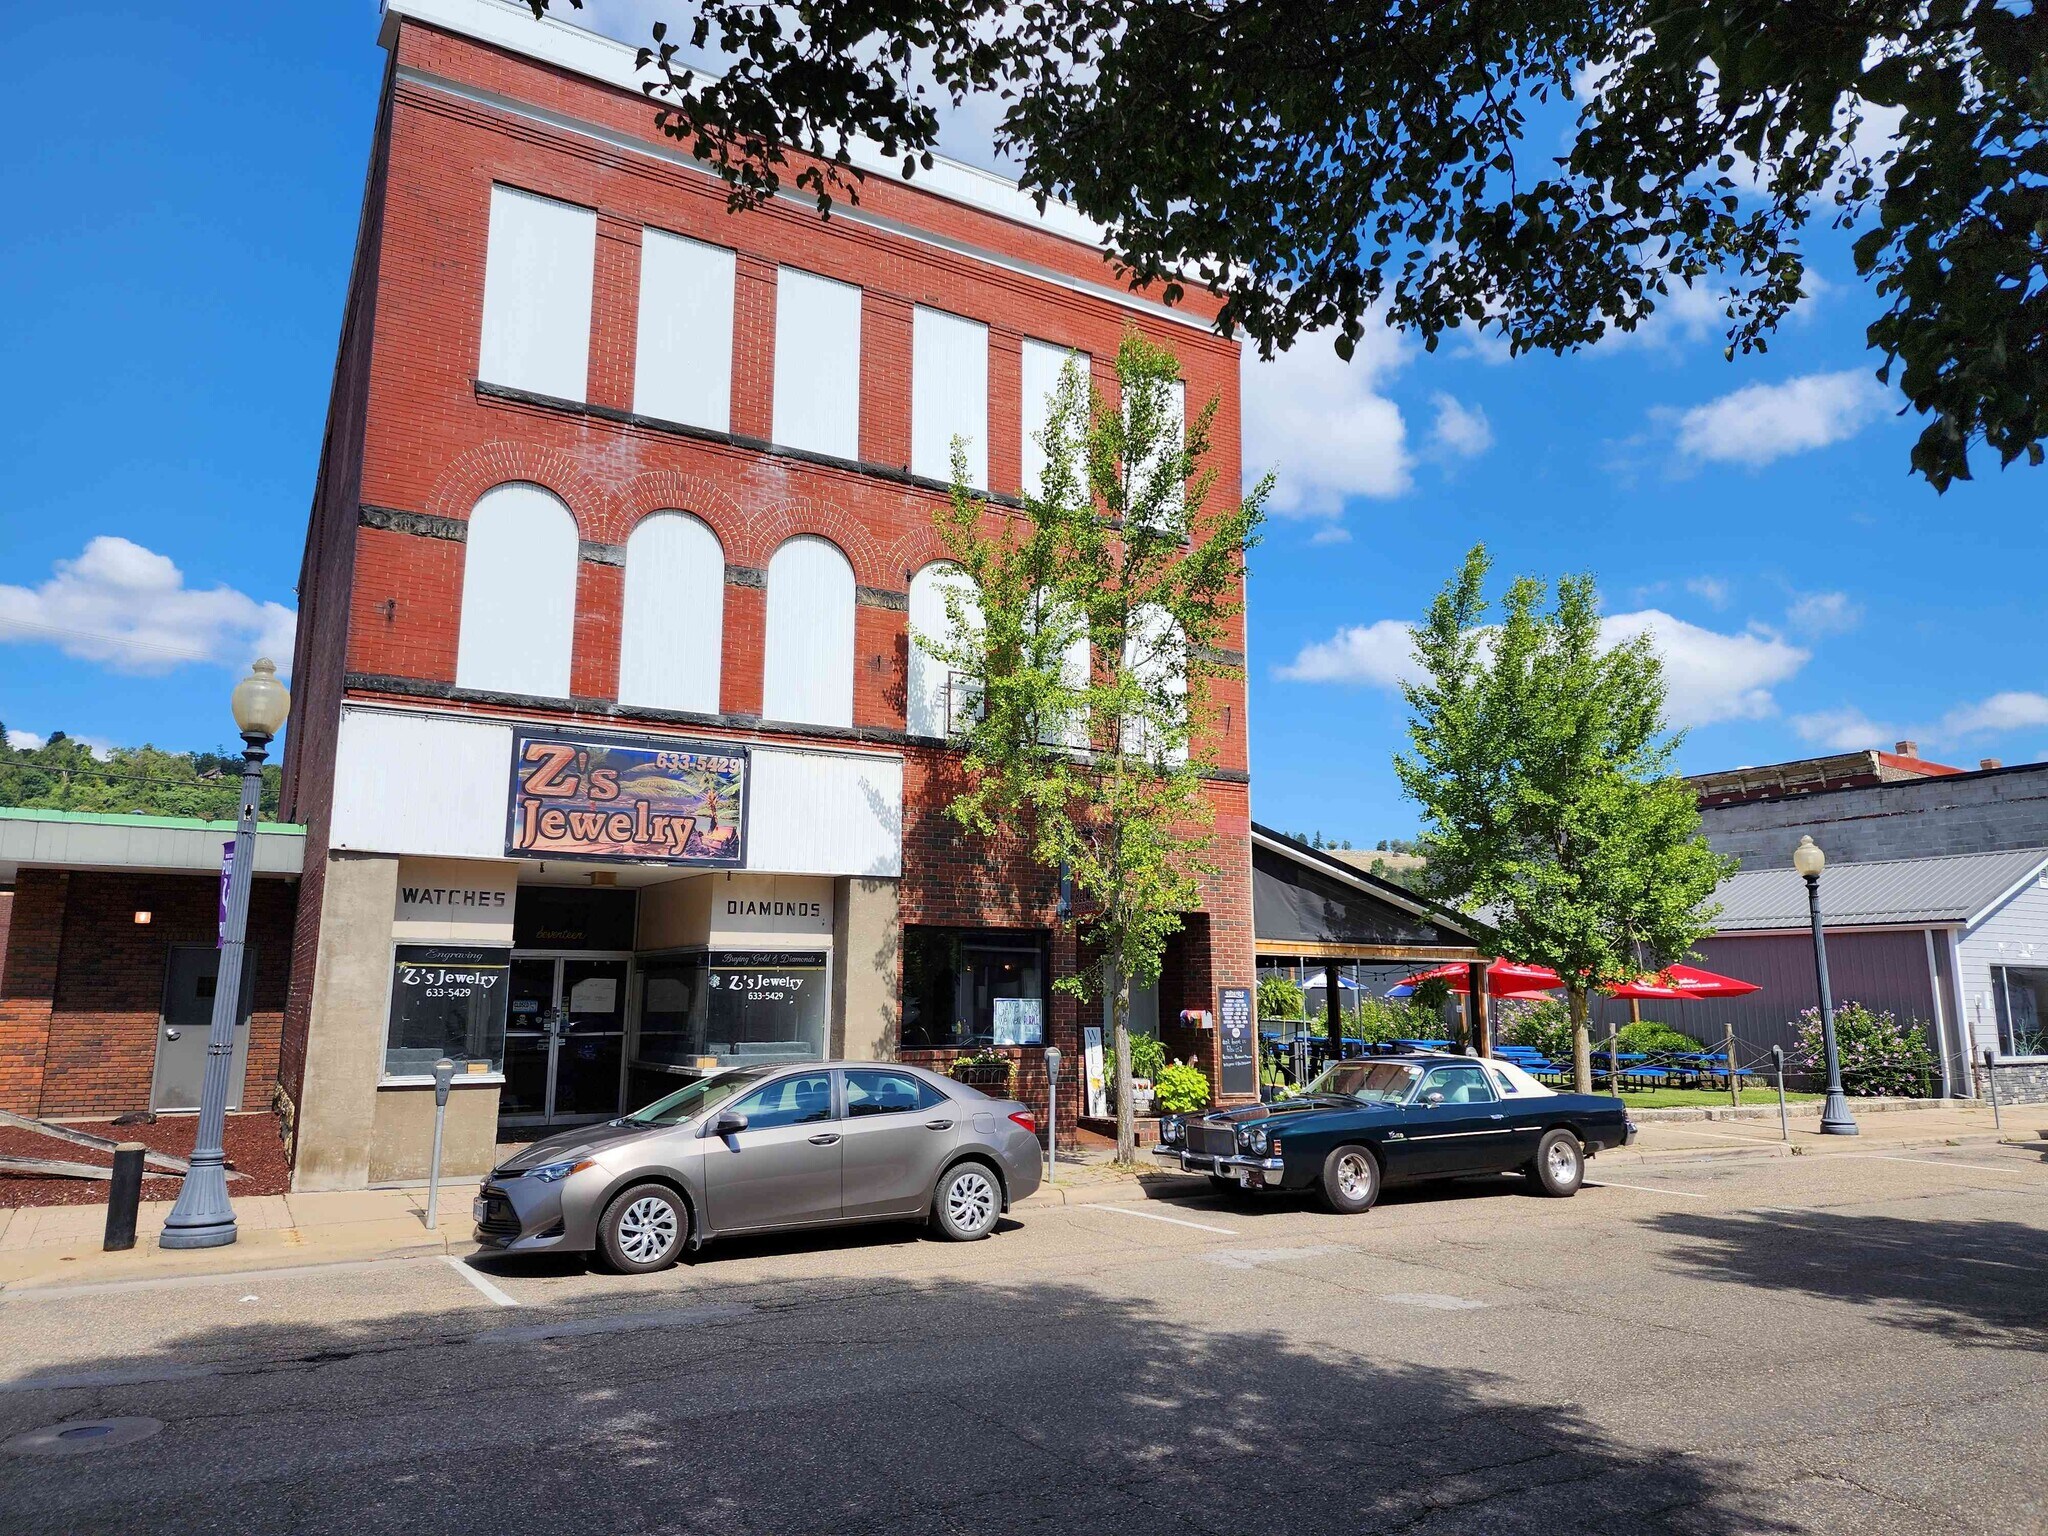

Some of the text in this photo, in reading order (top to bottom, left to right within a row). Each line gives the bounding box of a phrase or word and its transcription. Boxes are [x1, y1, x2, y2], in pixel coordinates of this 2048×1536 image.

[655, 751, 740, 774] 633-5429
[523, 743, 621, 800] Z's
[520, 797, 697, 855] Jewelry
[402, 887, 506, 907] WATCHES
[727, 900, 820, 917] DIAMONDS
[424, 947, 484, 962] Engraving
[721, 953, 750, 966] Buying
[752, 953, 770, 965] Gold
[779, 954, 816, 964] Diamonds
[402, 967, 498, 989] Z's Jewelry
[728, 974, 804, 991] Z's Jewelry
[425, 988, 471, 998] 633-5429
[747, 992, 784, 1001] 633-5429
